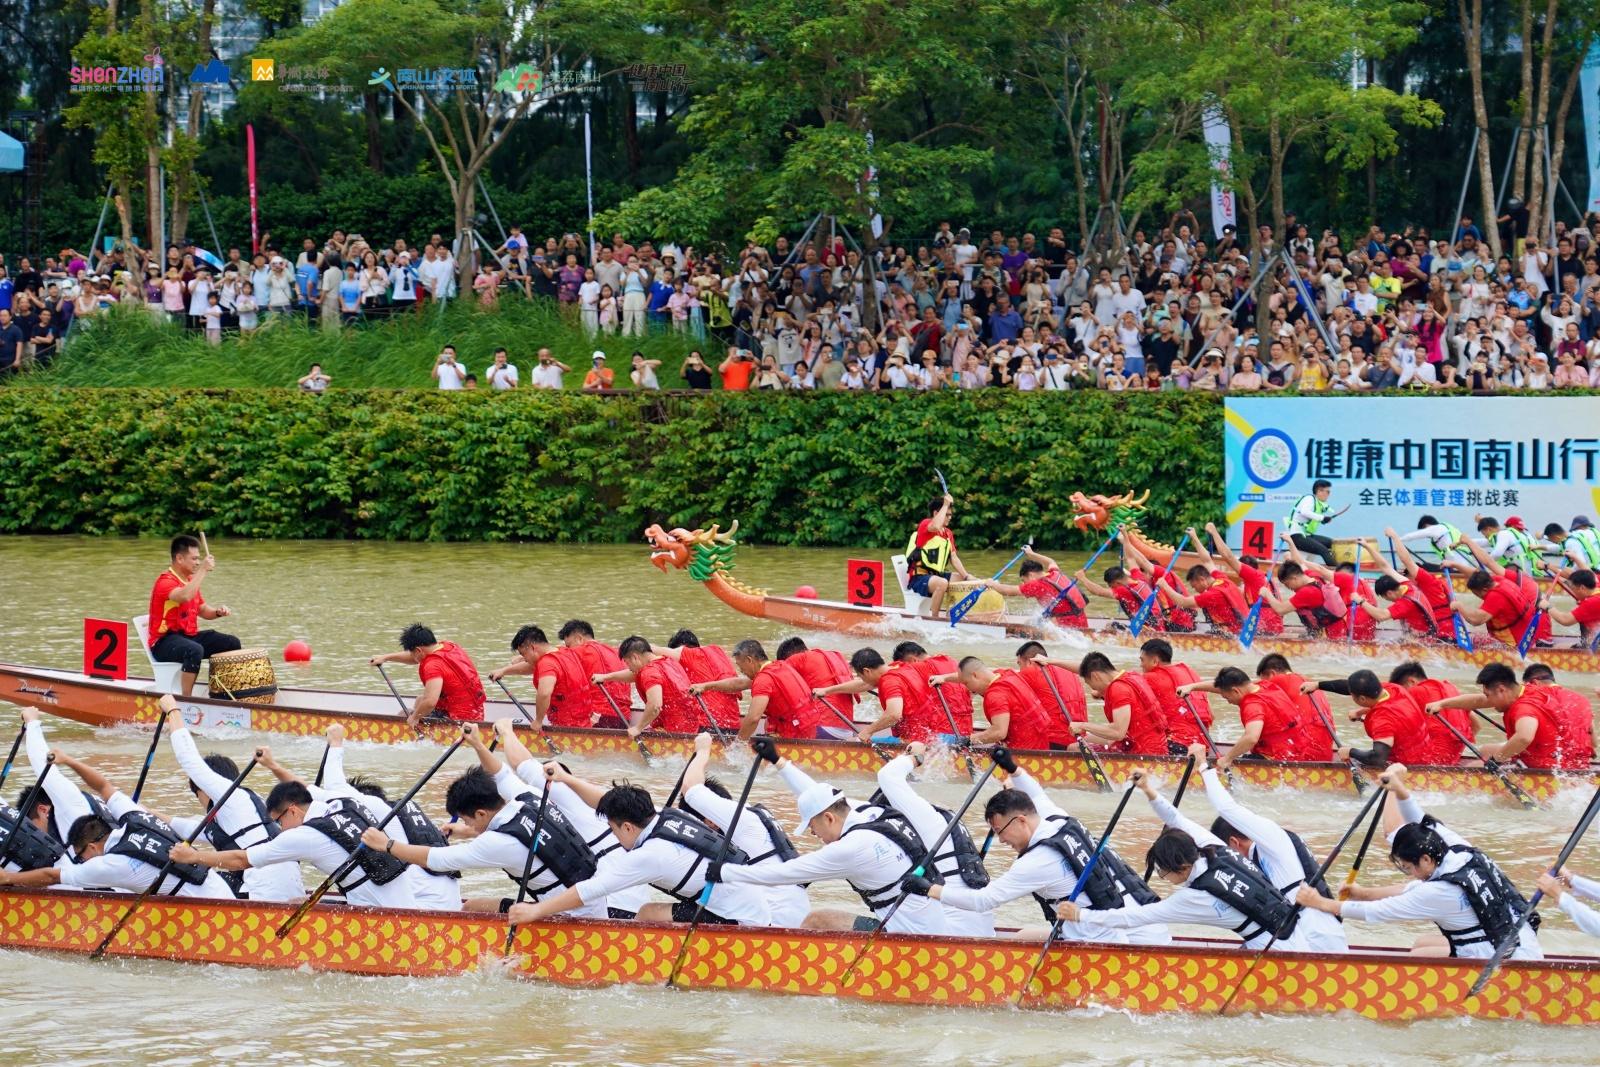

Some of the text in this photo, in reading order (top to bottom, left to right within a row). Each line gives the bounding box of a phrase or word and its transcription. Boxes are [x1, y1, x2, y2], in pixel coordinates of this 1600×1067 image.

[1304, 437, 1600, 480] 健康中国南山行
[1359, 488, 1519, 507] 全民体重管理挑战赛
[1248, 526, 1268, 554] 4
[856, 566, 876, 600] 3
[93, 628, 119, 672] 2
